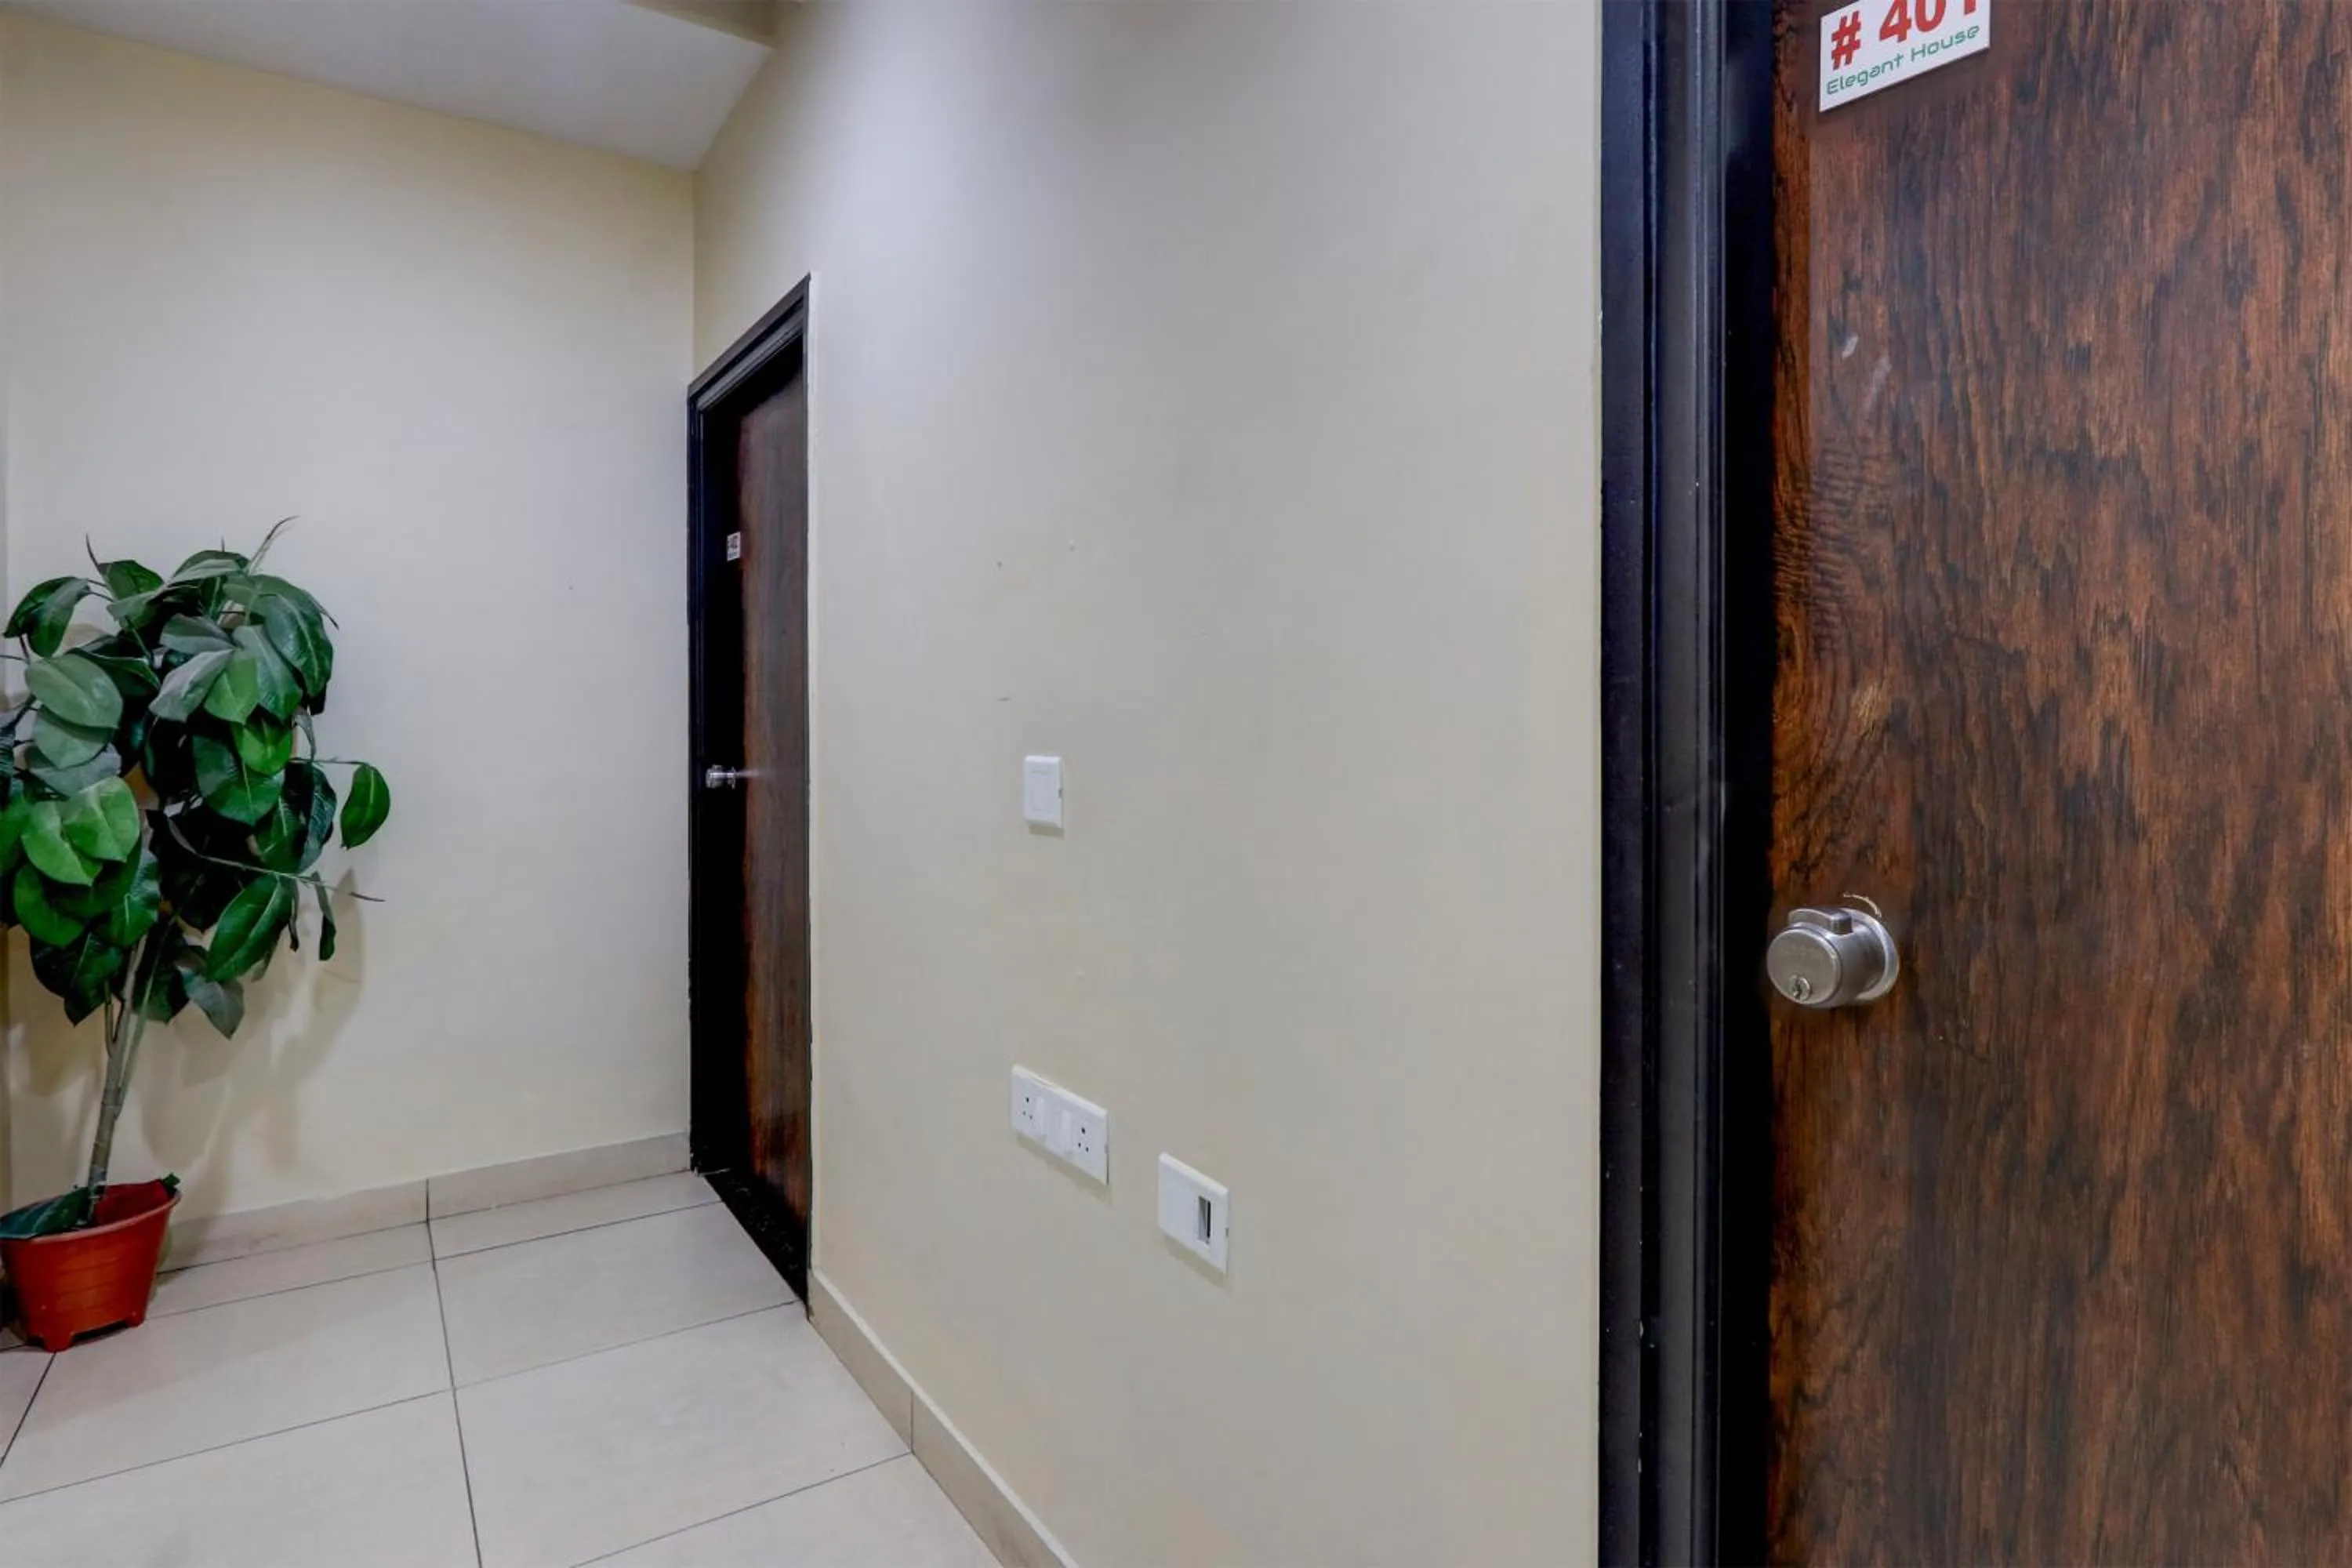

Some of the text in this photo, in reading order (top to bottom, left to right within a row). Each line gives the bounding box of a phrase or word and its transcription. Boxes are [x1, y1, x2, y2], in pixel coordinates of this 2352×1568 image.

[1827, 25, 1980, 95] Elegant House
[1831, 0, 1976, 71] # 40
